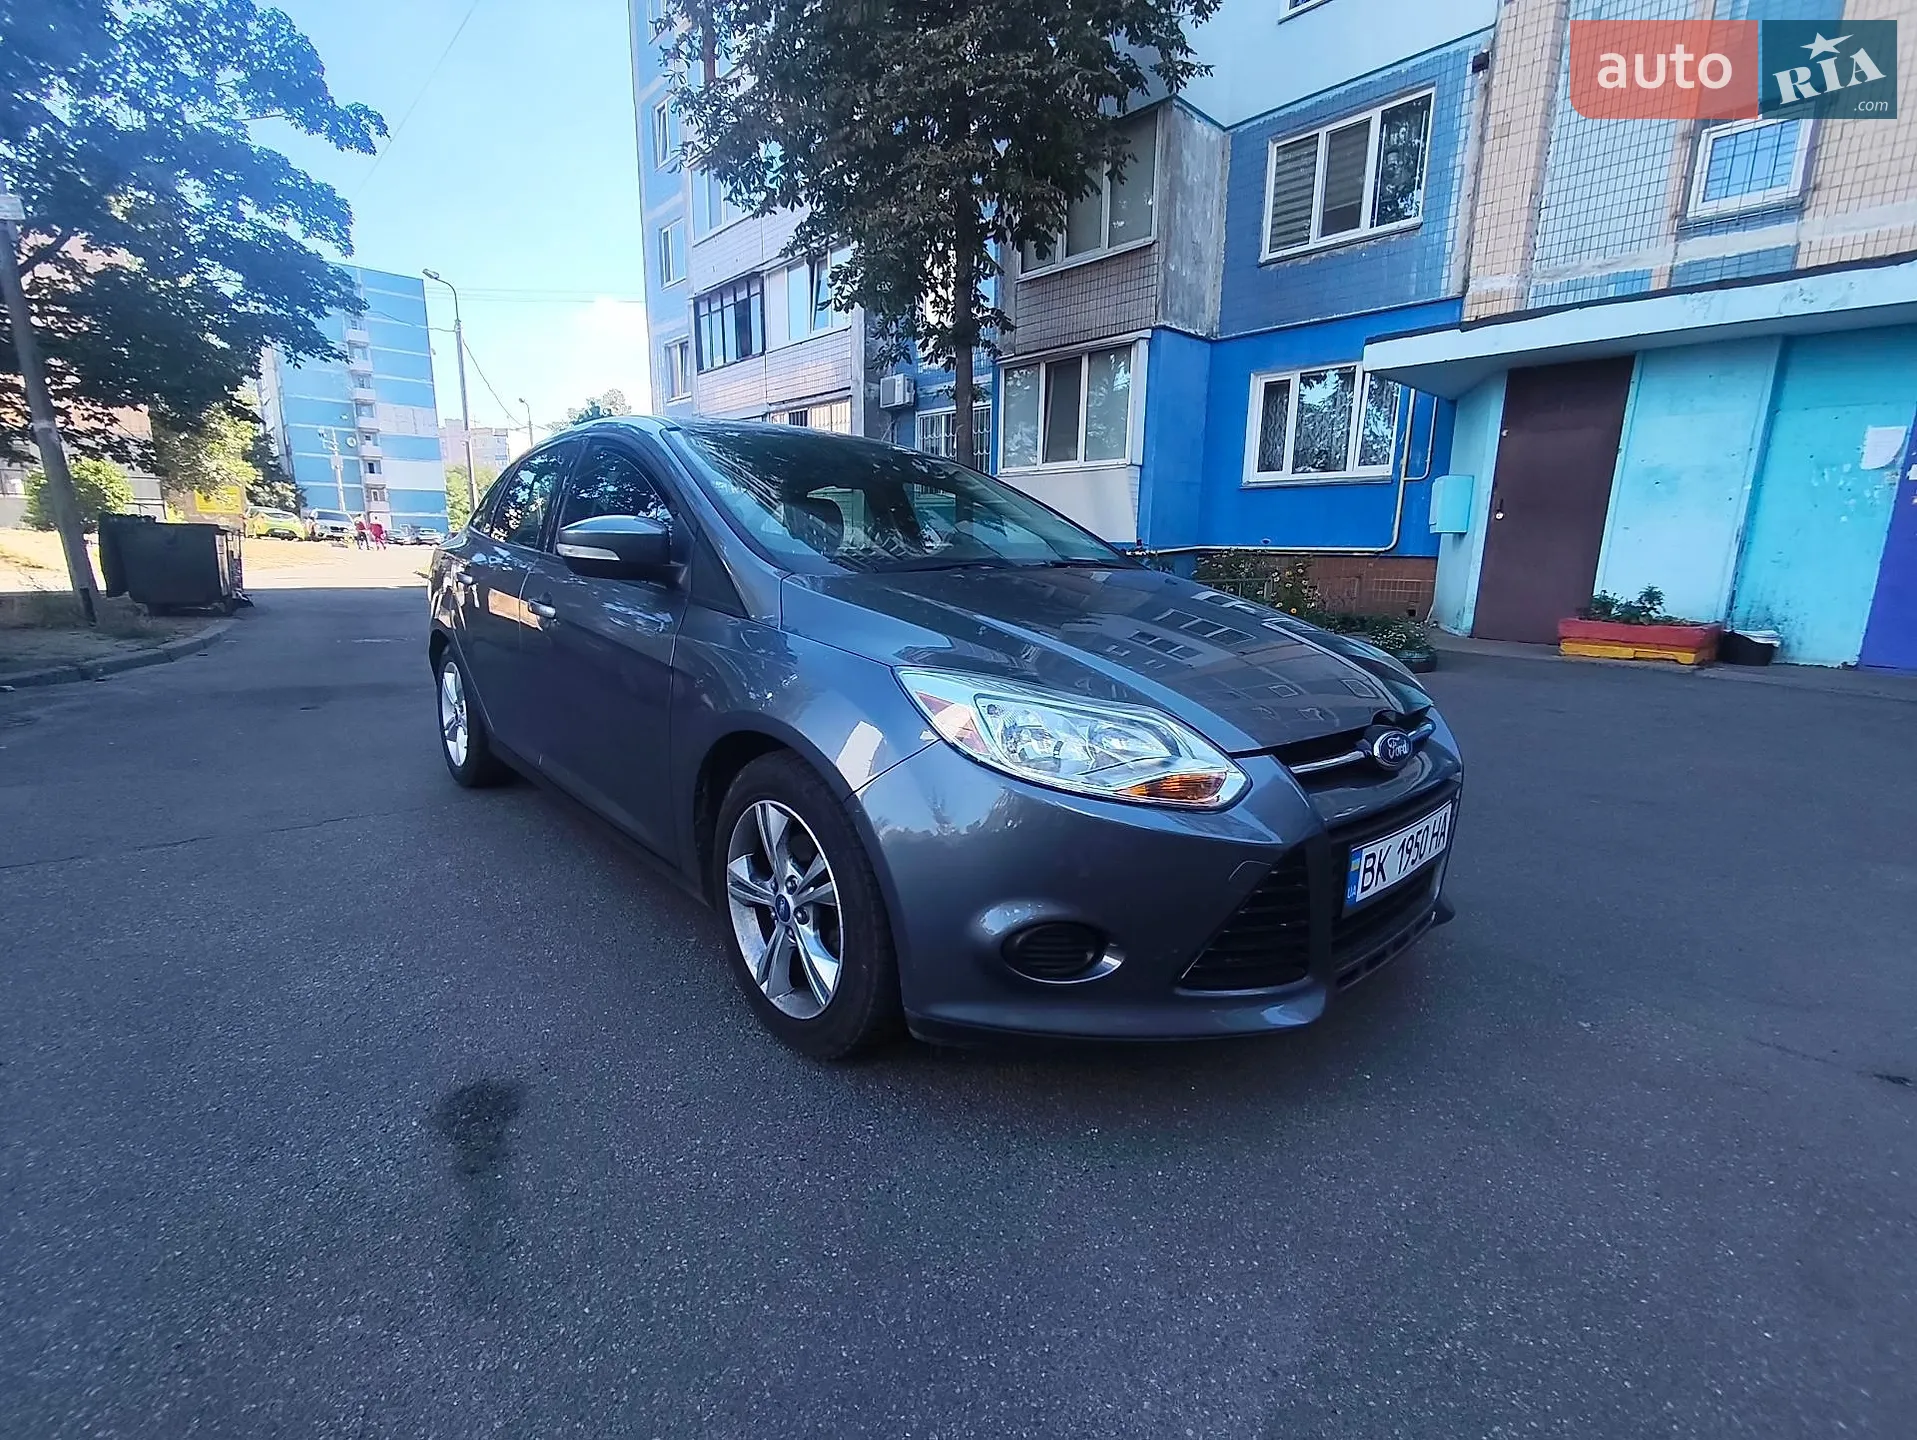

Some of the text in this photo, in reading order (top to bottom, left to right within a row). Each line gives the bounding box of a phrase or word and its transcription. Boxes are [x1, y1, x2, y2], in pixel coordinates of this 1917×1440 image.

[1387, 736, 1408, 759] Ford
[1360, 811, 1448, 894] BK 1950 HA
[1347, 885, 1357, 899] UA
